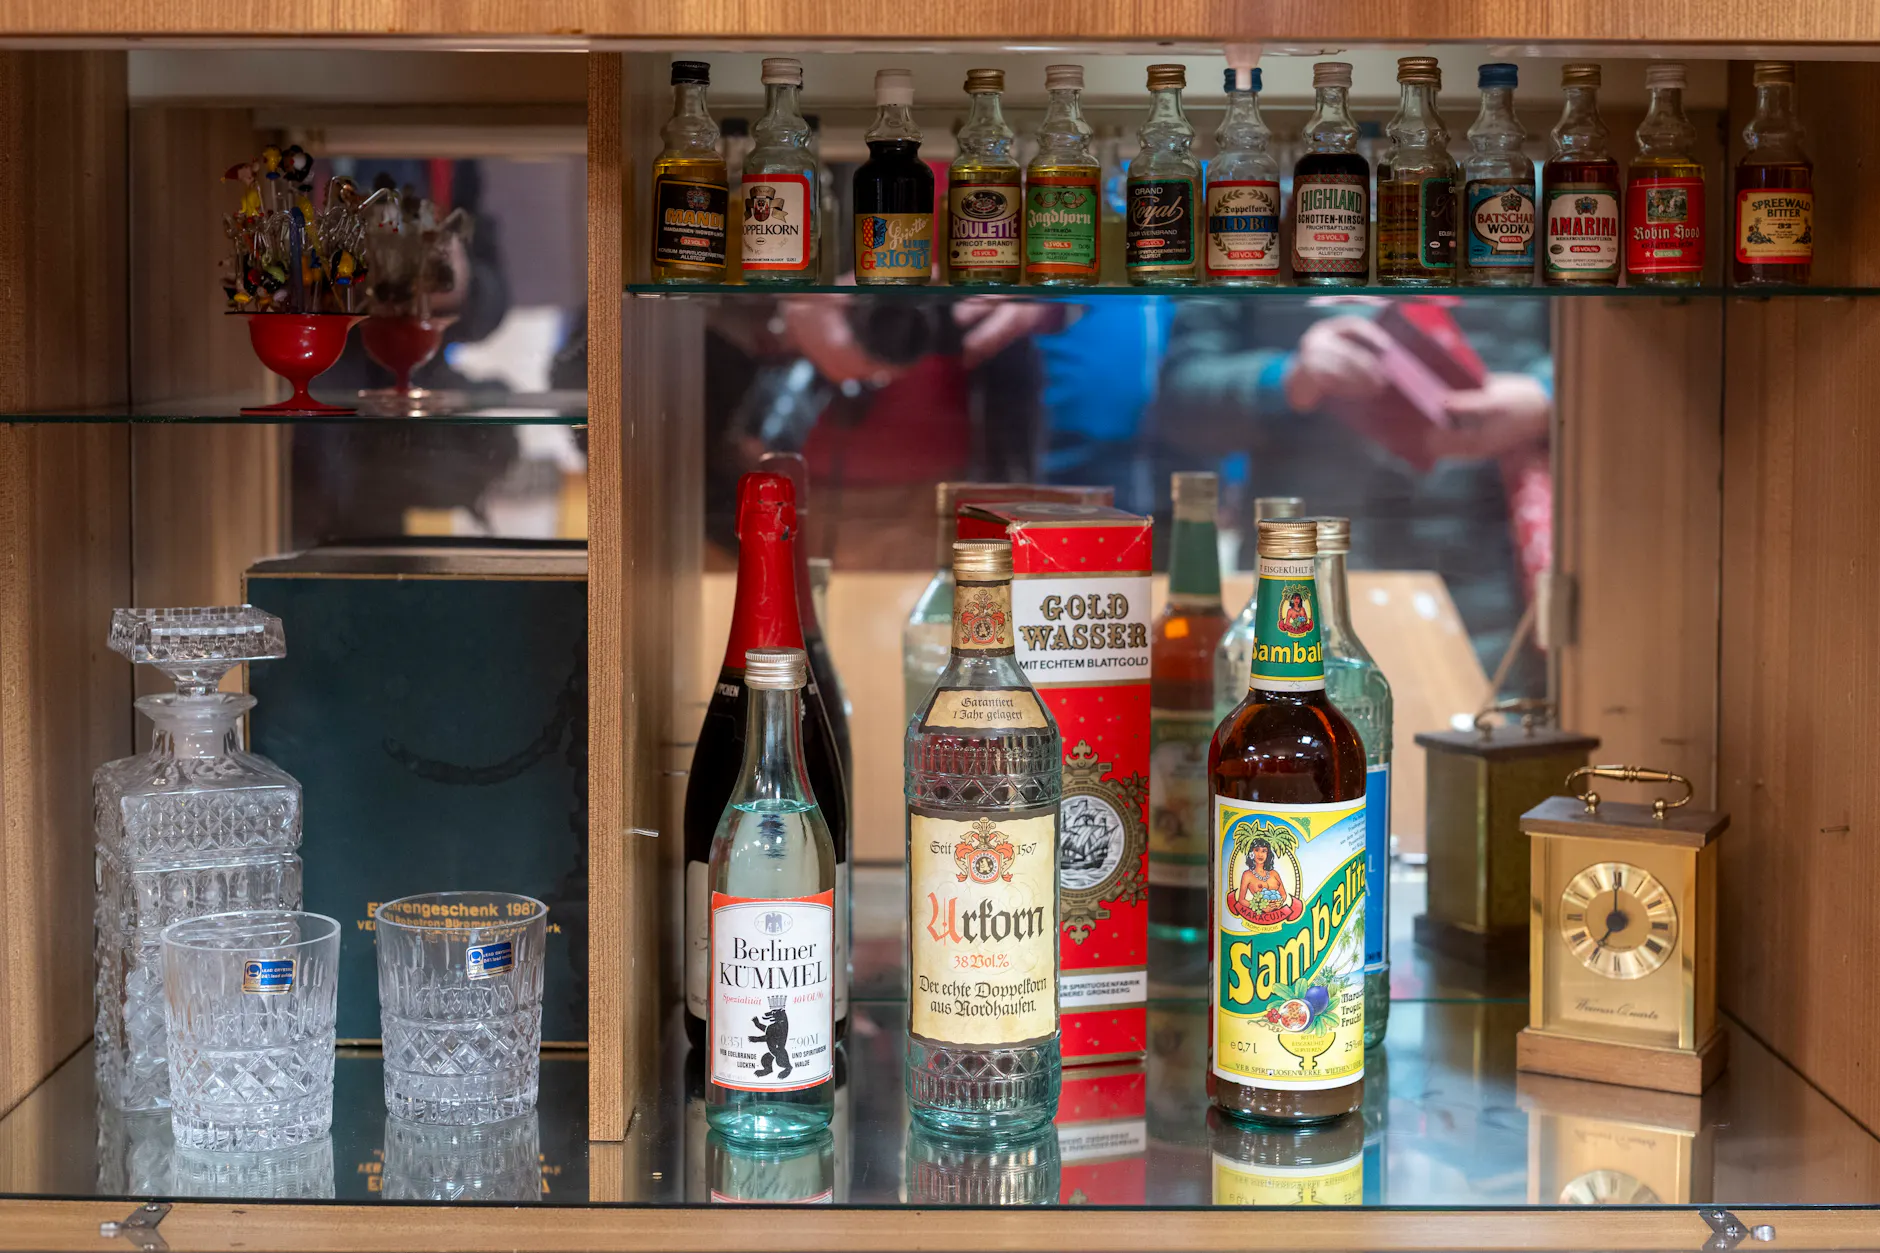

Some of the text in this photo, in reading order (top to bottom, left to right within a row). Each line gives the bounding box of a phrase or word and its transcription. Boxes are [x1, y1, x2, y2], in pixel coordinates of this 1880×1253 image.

[1135, 187, 1163, 195] GRAND
[1301, 188, 1362, 214] HIGHLAND
[1752, 198, 1810, 211] SPREEWALD
[1131, 196, 1184, 230] Royal
[1224, 205, 1267, 215] Doppelkorn
[1767, 208, 1800, 217] BITTER
[953, 213, 1017, 238] ROULETTE
[1028, 209, 1091, 228] Jagdhorn
[1298, 214, 1364, 225] SCHOTTEN-KIRSCH
[742, 224, 799, 235] OPPELKORN
[1487, 224, 1530, 234] WODKA
[1550, 217, 1616, 236] AMARINA
[1633, 224, 1700, 240] Robin Hood
[1264, 565, 1308, 574] EISGEKÜHLT
[1040, 593, 1129, 621] GOLD
[1019, 623, 1148, 651] WASSER
[1019, 657, 1148, 670] MIT ECHTEM BLATTGOLD
[961, 698, 1014, 708] Garantiert
[960, 710, 983, 721] Jahr
[986, 710, 1023, 721] gelagert
[930, 841, 1037, 856] Seit 1507
[506, 902, 537, 917] 1987
[1241, 906, 1286, 922] MARACUJA
[927, 892, 1044, 946] Urkorn
[733, 937, 817, 961] Berliner
[719, 961, 828, 989] KÜMMEL
[919, 975, 1047, 1000] Der echte Doppelkorn
[723, 993, 762, 1005] Spezialität
[930, 1000, 951, 1015] aus
[791, 1051, 802, 1059] UND
[1235, 1063, 1249, 1071] VEB
